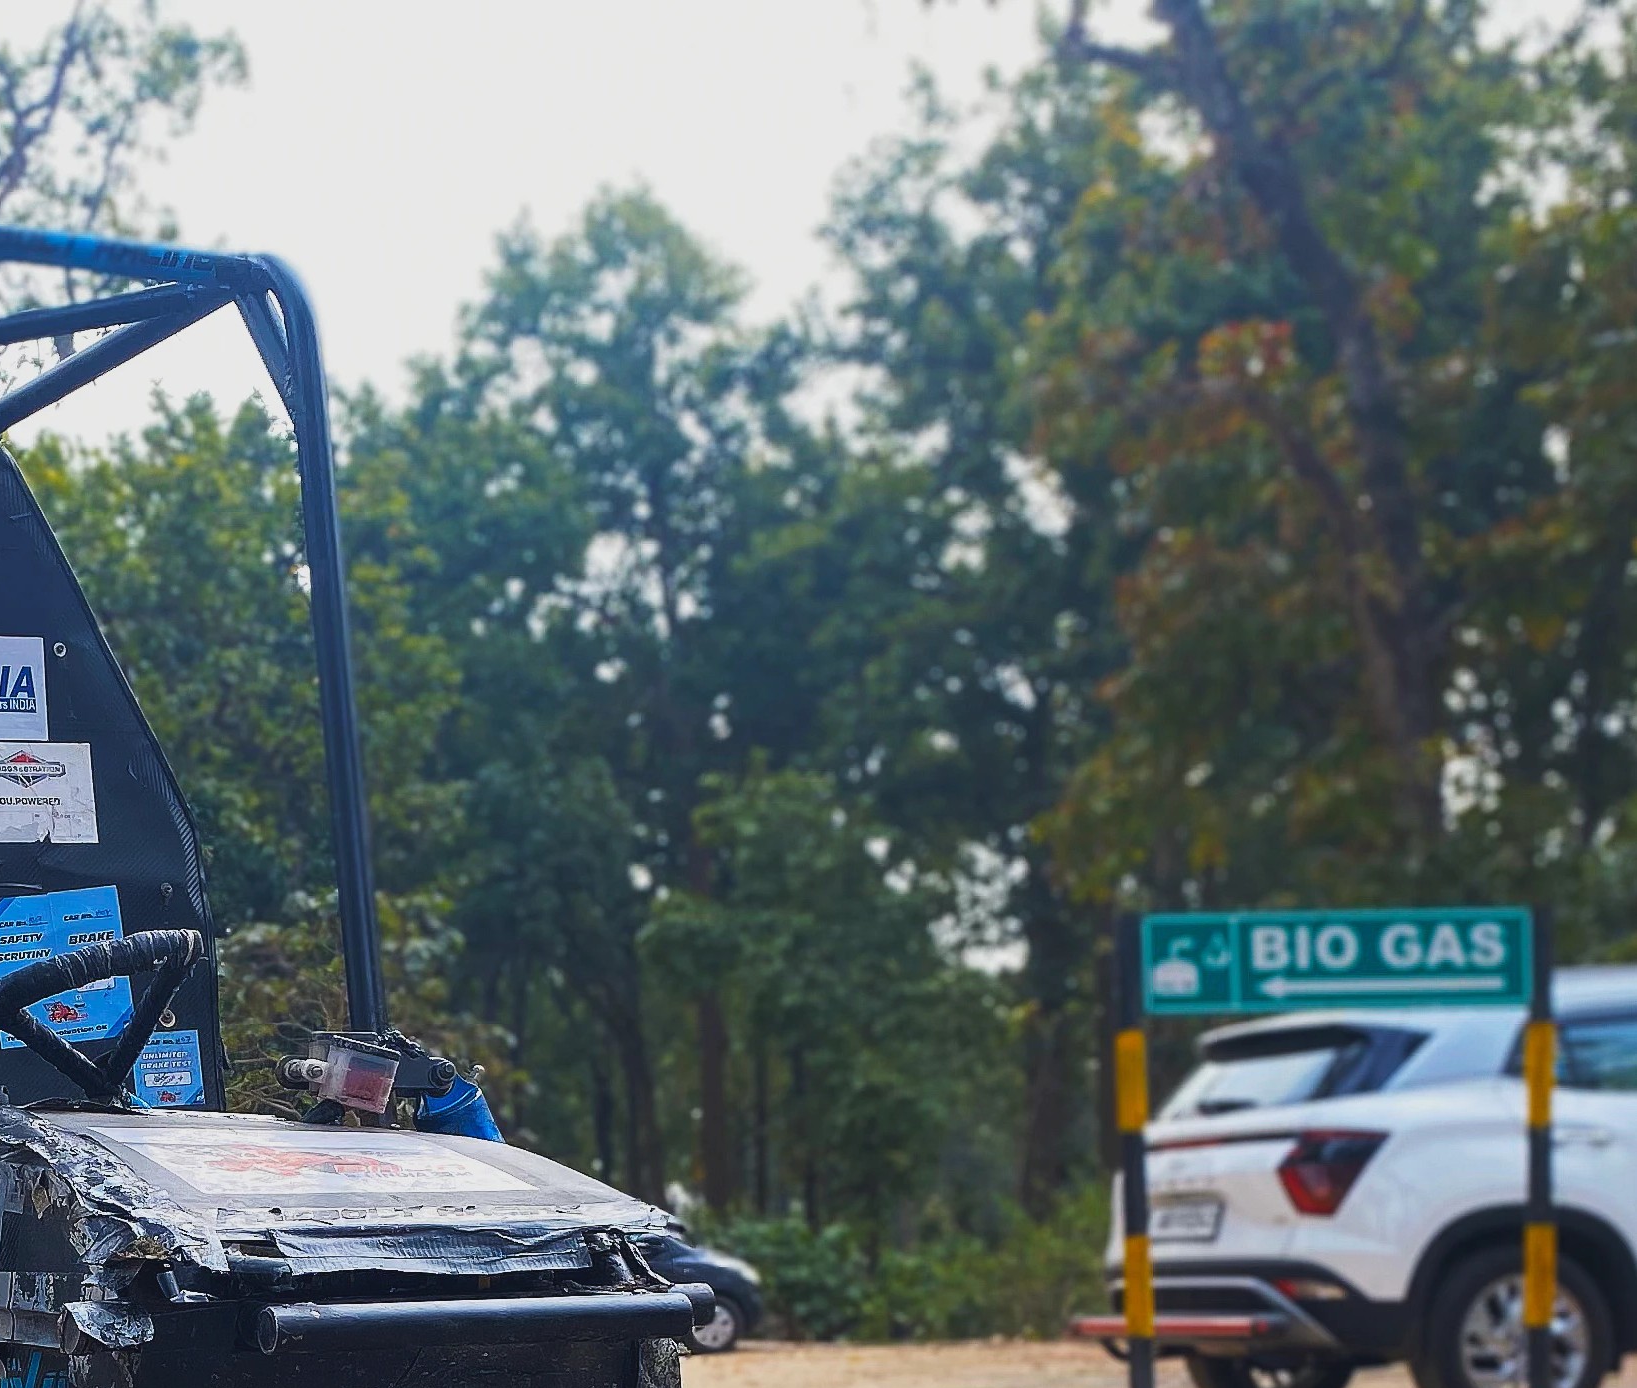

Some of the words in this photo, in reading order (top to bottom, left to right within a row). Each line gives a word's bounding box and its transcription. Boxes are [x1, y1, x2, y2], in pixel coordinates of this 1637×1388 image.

[9, 699, 36, 710] INDIA
[0, 932, 43, 945] SAFETY
[68, 931, 114, 945] BRAKE
[1252, 925, 1359, 970] BIO
[1380, 923, 1505, 969] GAS
[143, 1052, 188, 1060] UNLIMITED
